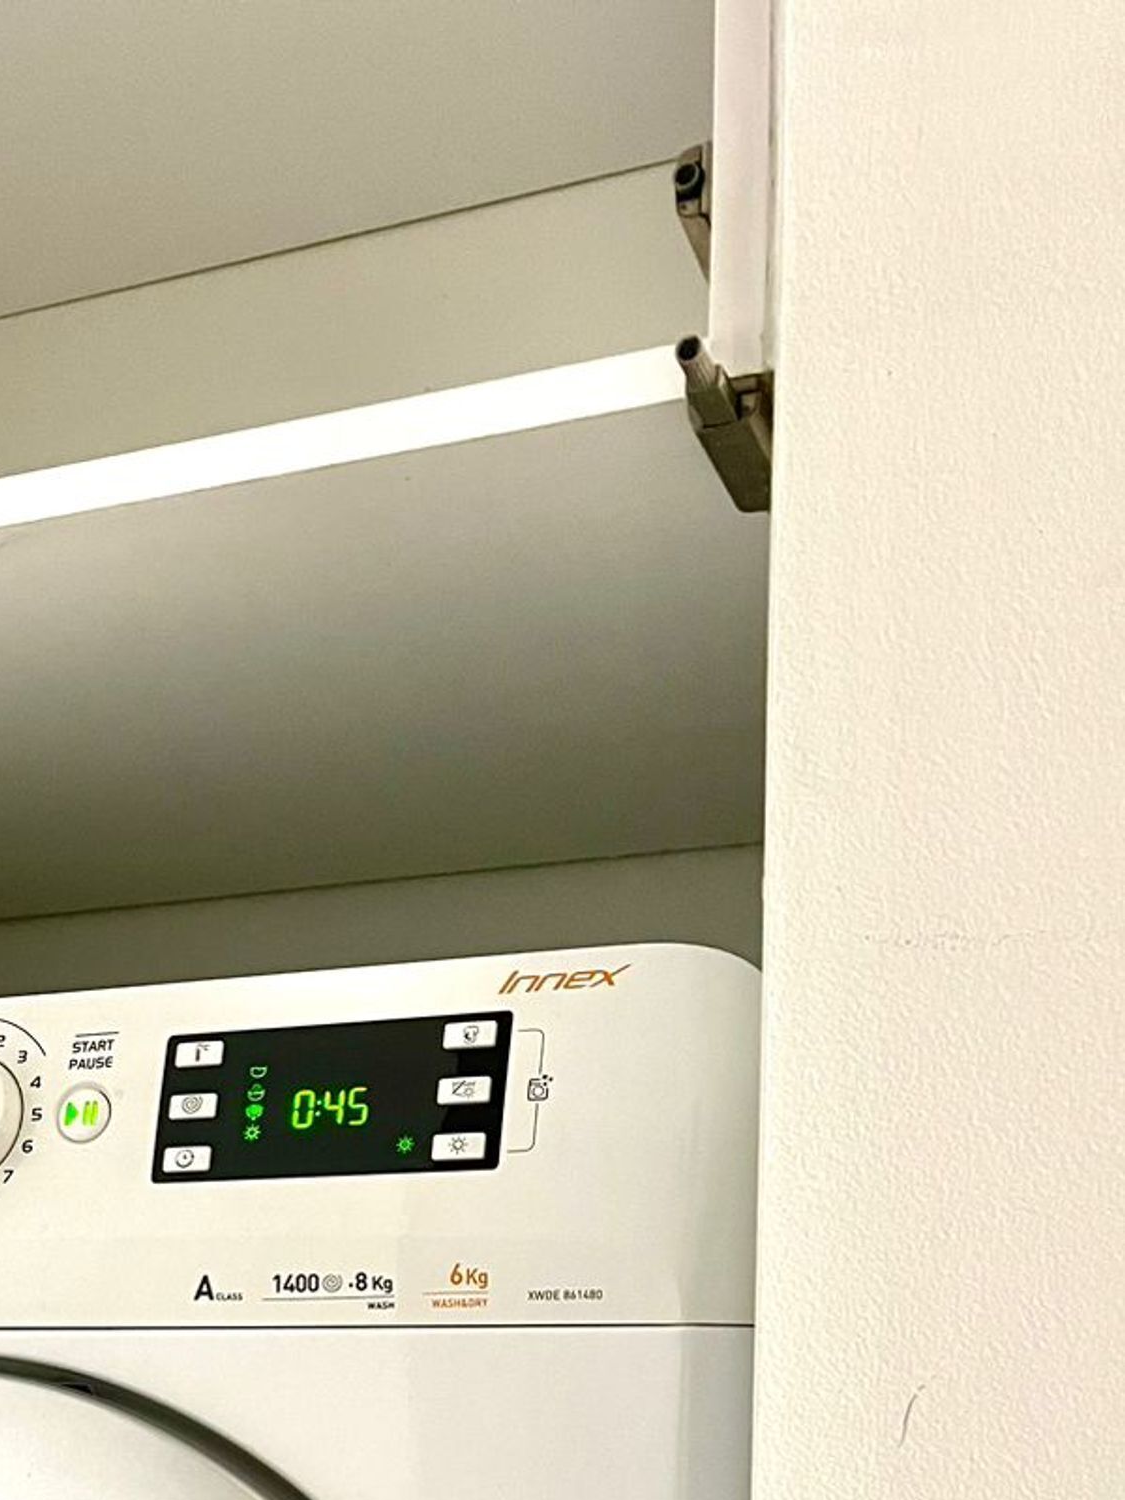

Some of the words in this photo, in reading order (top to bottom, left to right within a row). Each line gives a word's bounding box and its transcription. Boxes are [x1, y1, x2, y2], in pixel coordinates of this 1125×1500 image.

[72, 1039, 115, 1053] START
[17, 1050, 28, 1063] 3
[68, 1057, 113, 1070] PAUSE
[29, 1076, 42, 1089] 4
[31, 1108, 43, 1121] 5
[291, 1086, 368, 1130] 0:45
[21, 1140, 33, 1154] 6
[2, 1170, 14, 1184] 7
[193, 1275, 213, 1301] A
[215, 1292, 244, 1302] CLASS
[272, 1274, 320, 1293] 1400
[372, 1276, 394, 1294] Kg
[527, 1289, 560, 1301] XWDE
[563, 1289, 604, 1301] 861480
[367, 1302, 395, 1311] WASH
